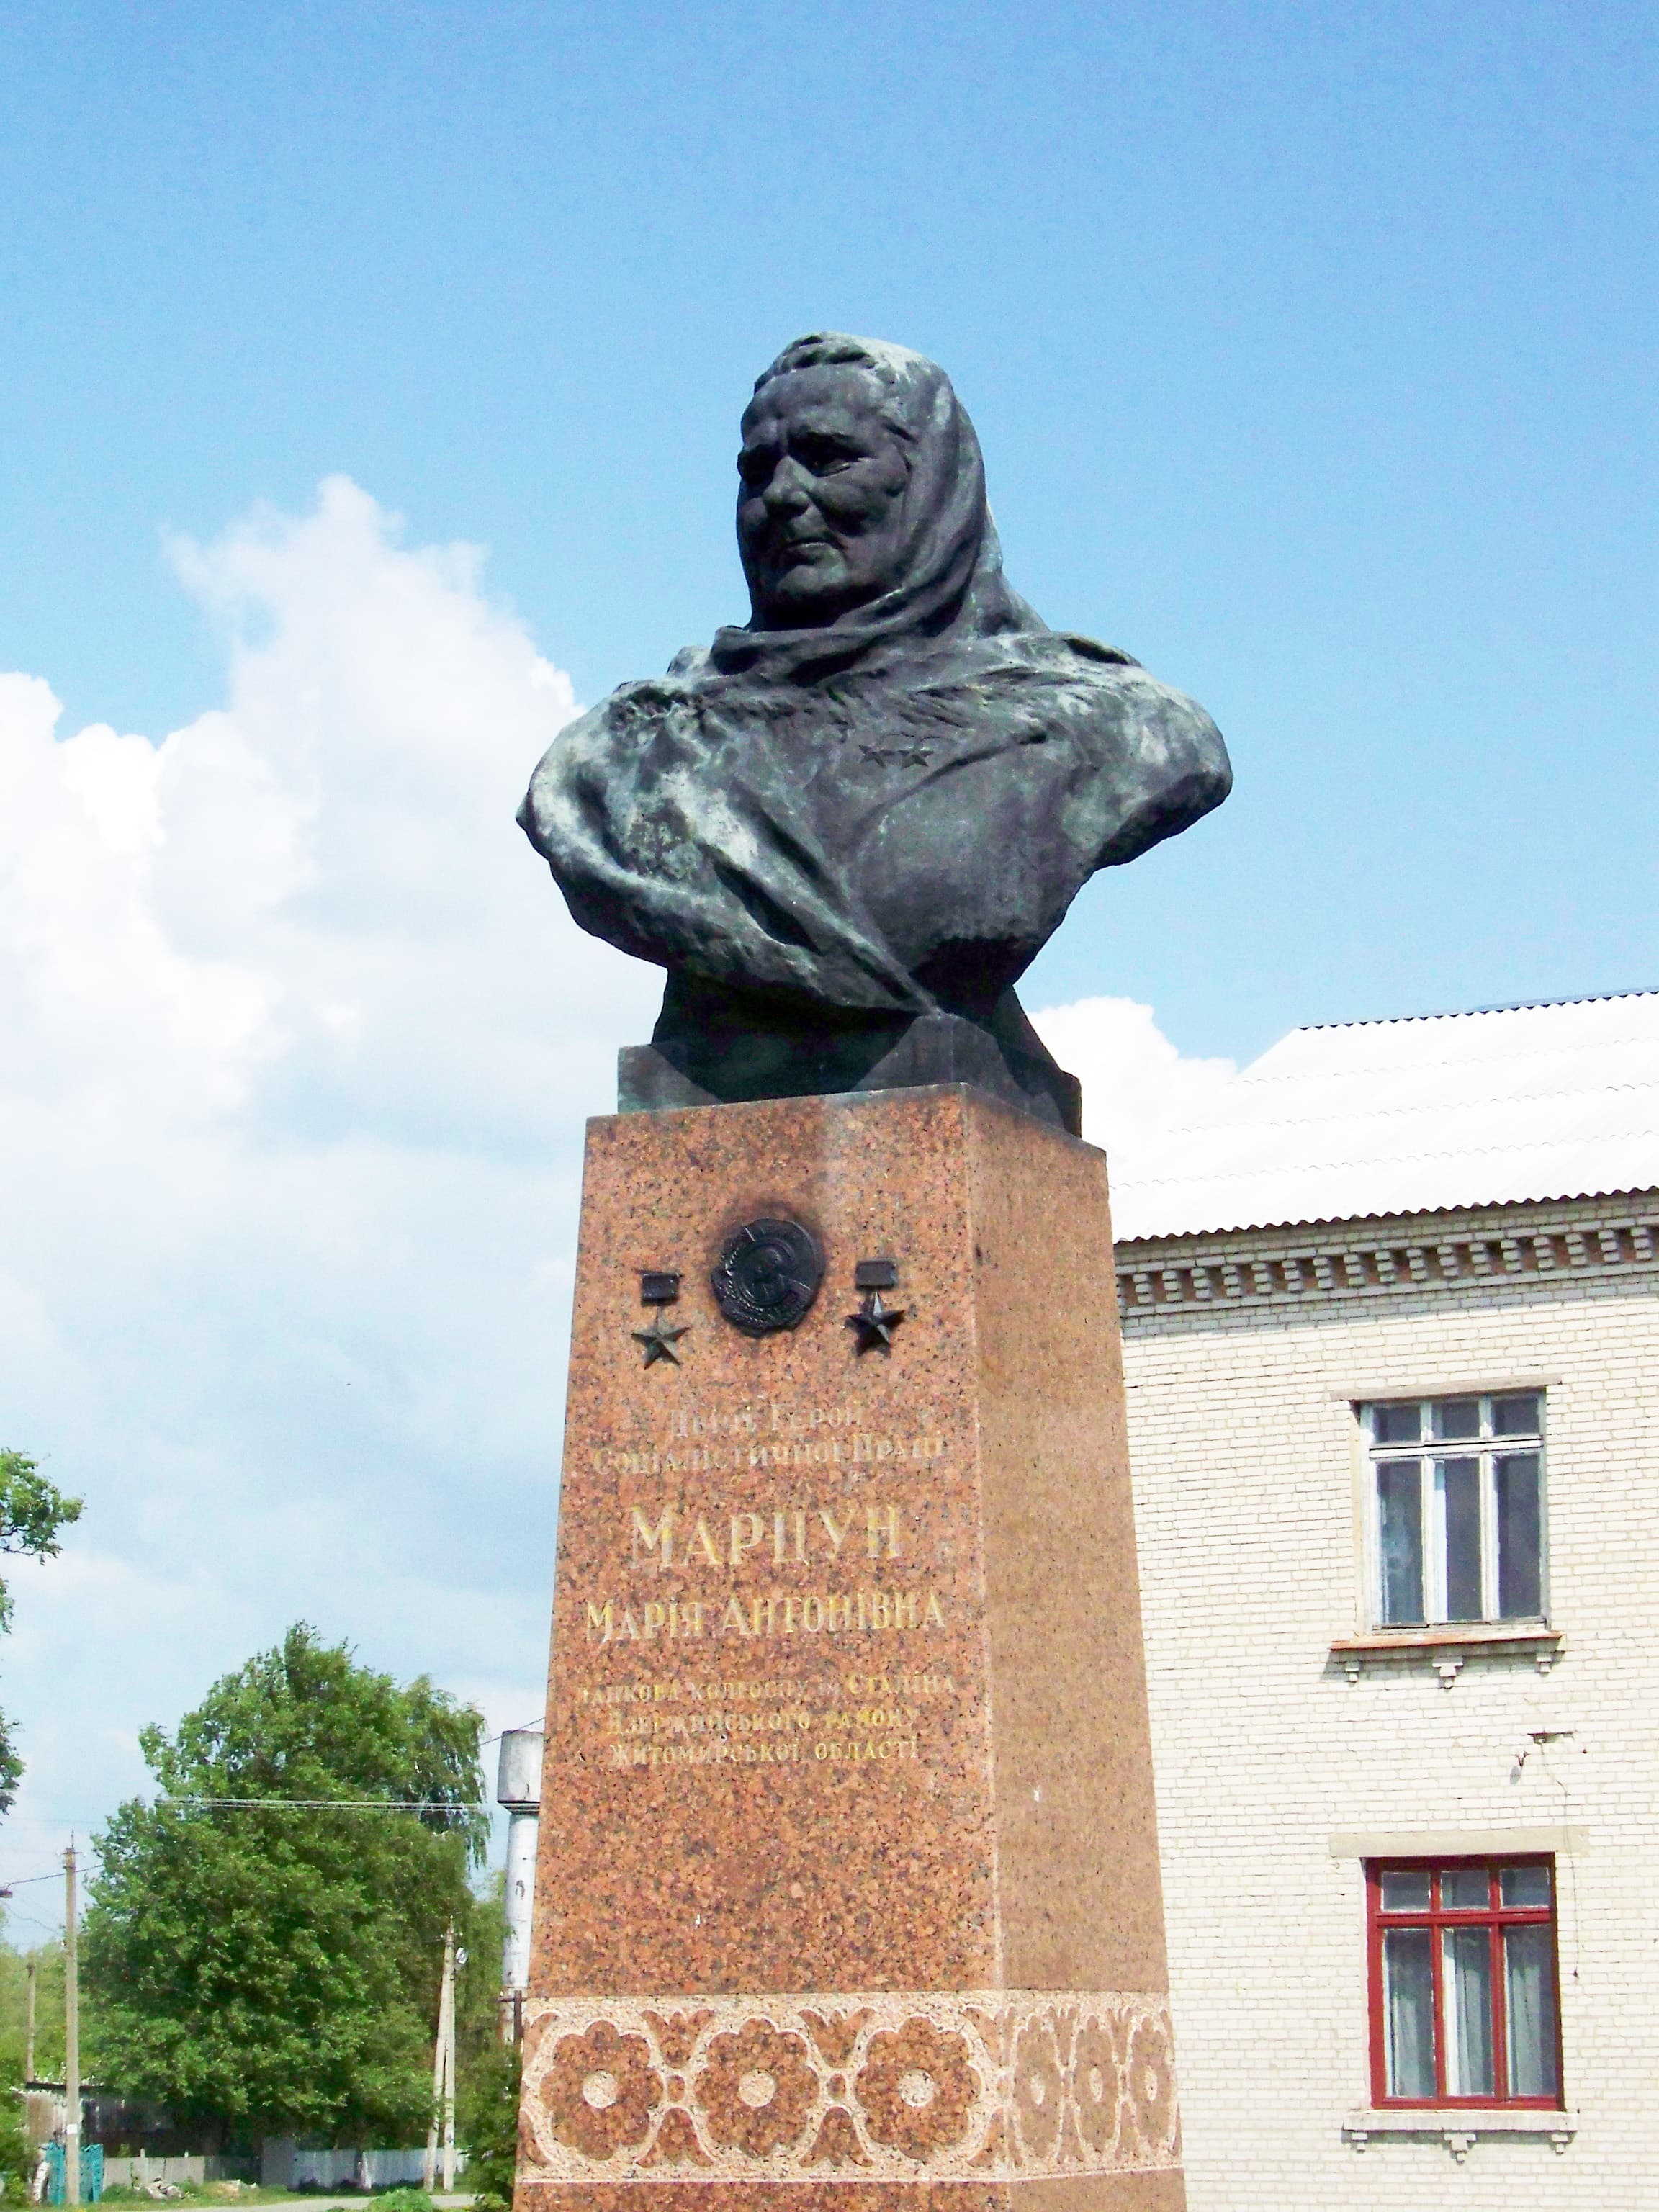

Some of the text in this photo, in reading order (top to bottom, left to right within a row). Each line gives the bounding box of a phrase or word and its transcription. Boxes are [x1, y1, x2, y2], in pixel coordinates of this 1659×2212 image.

[629, 1506, 902, 1568] МАРЦУН
[586, 1593, 947, 1642] МАРІЯ АНТОНІВНА
[848, 1674, 956, 1694] СТАЛІНА
[611, 1736, 918, 1765] ЖИТОМИРСЬКОЇ ОБЛАСТІ
